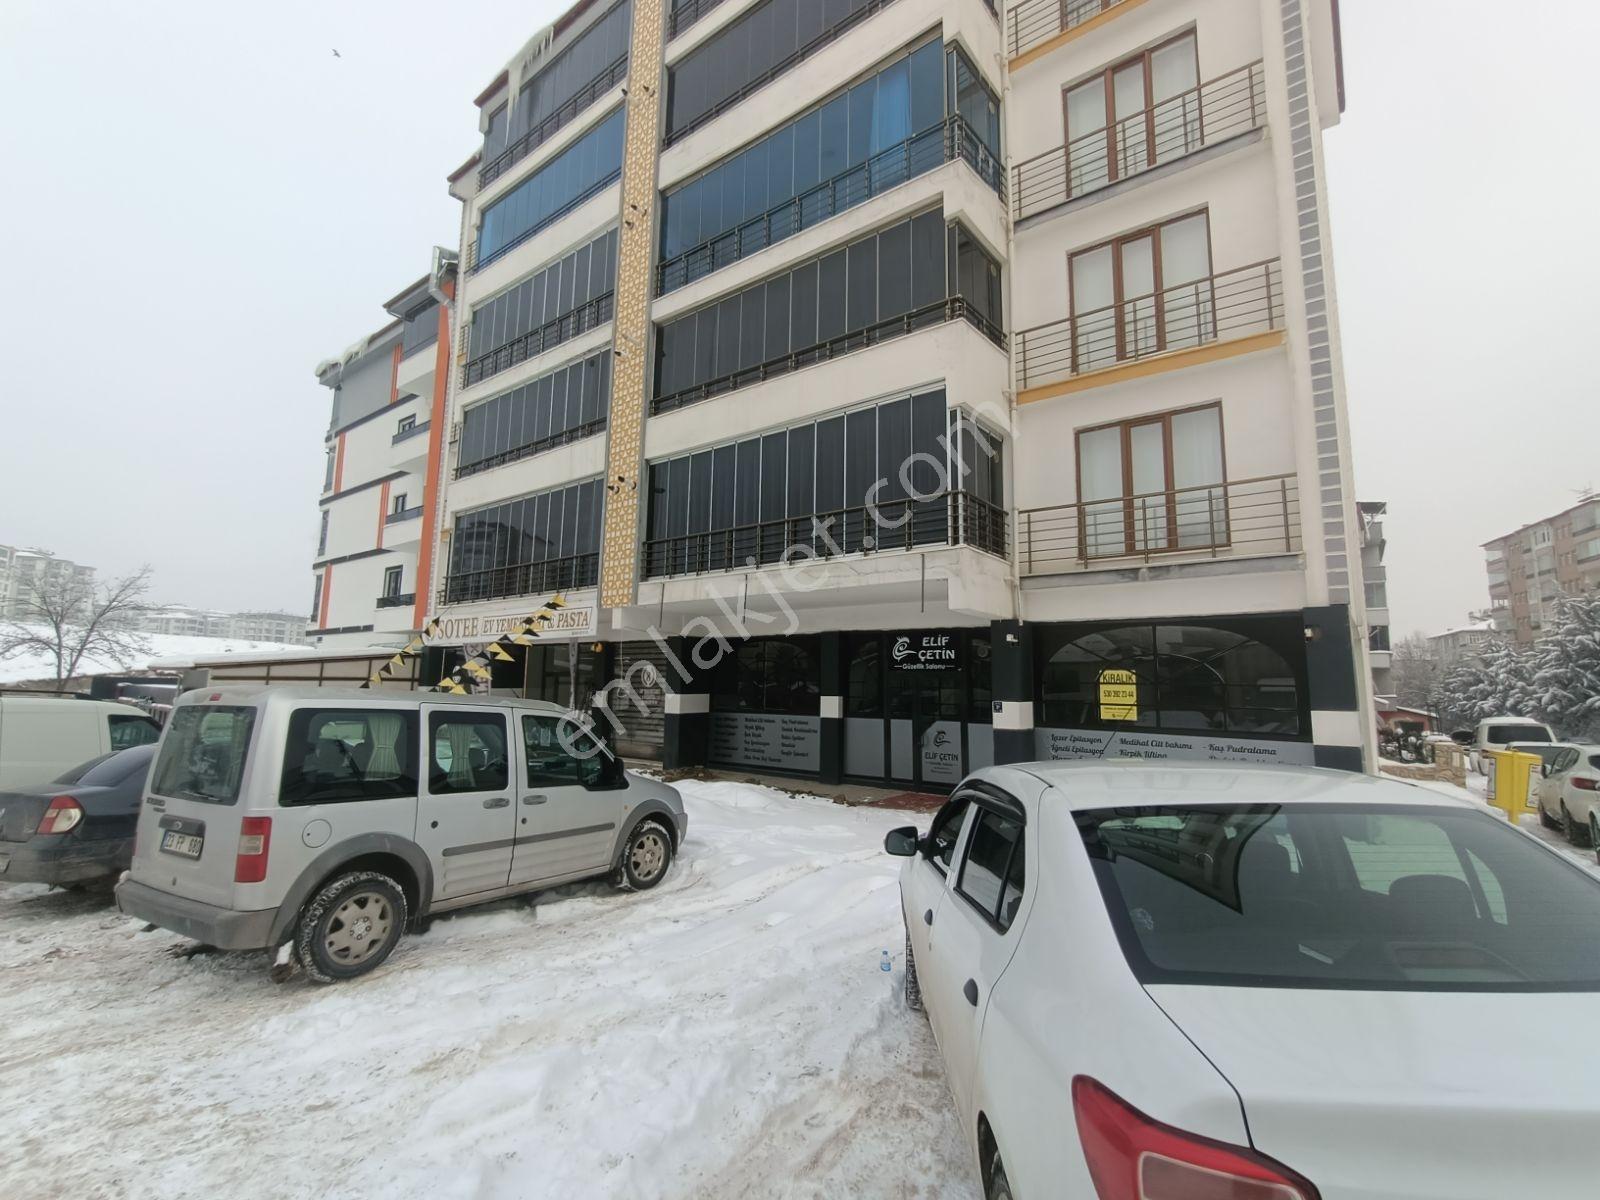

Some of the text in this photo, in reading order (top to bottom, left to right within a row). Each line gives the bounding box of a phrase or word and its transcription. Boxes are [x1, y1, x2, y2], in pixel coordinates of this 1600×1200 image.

[557, 611, 589, 628] PASTA
[922, 634, 950, 646] ELİF
[918, 648, 955, 661] ÇETİN
[1226, 744, 1277, 755] Pudralama
